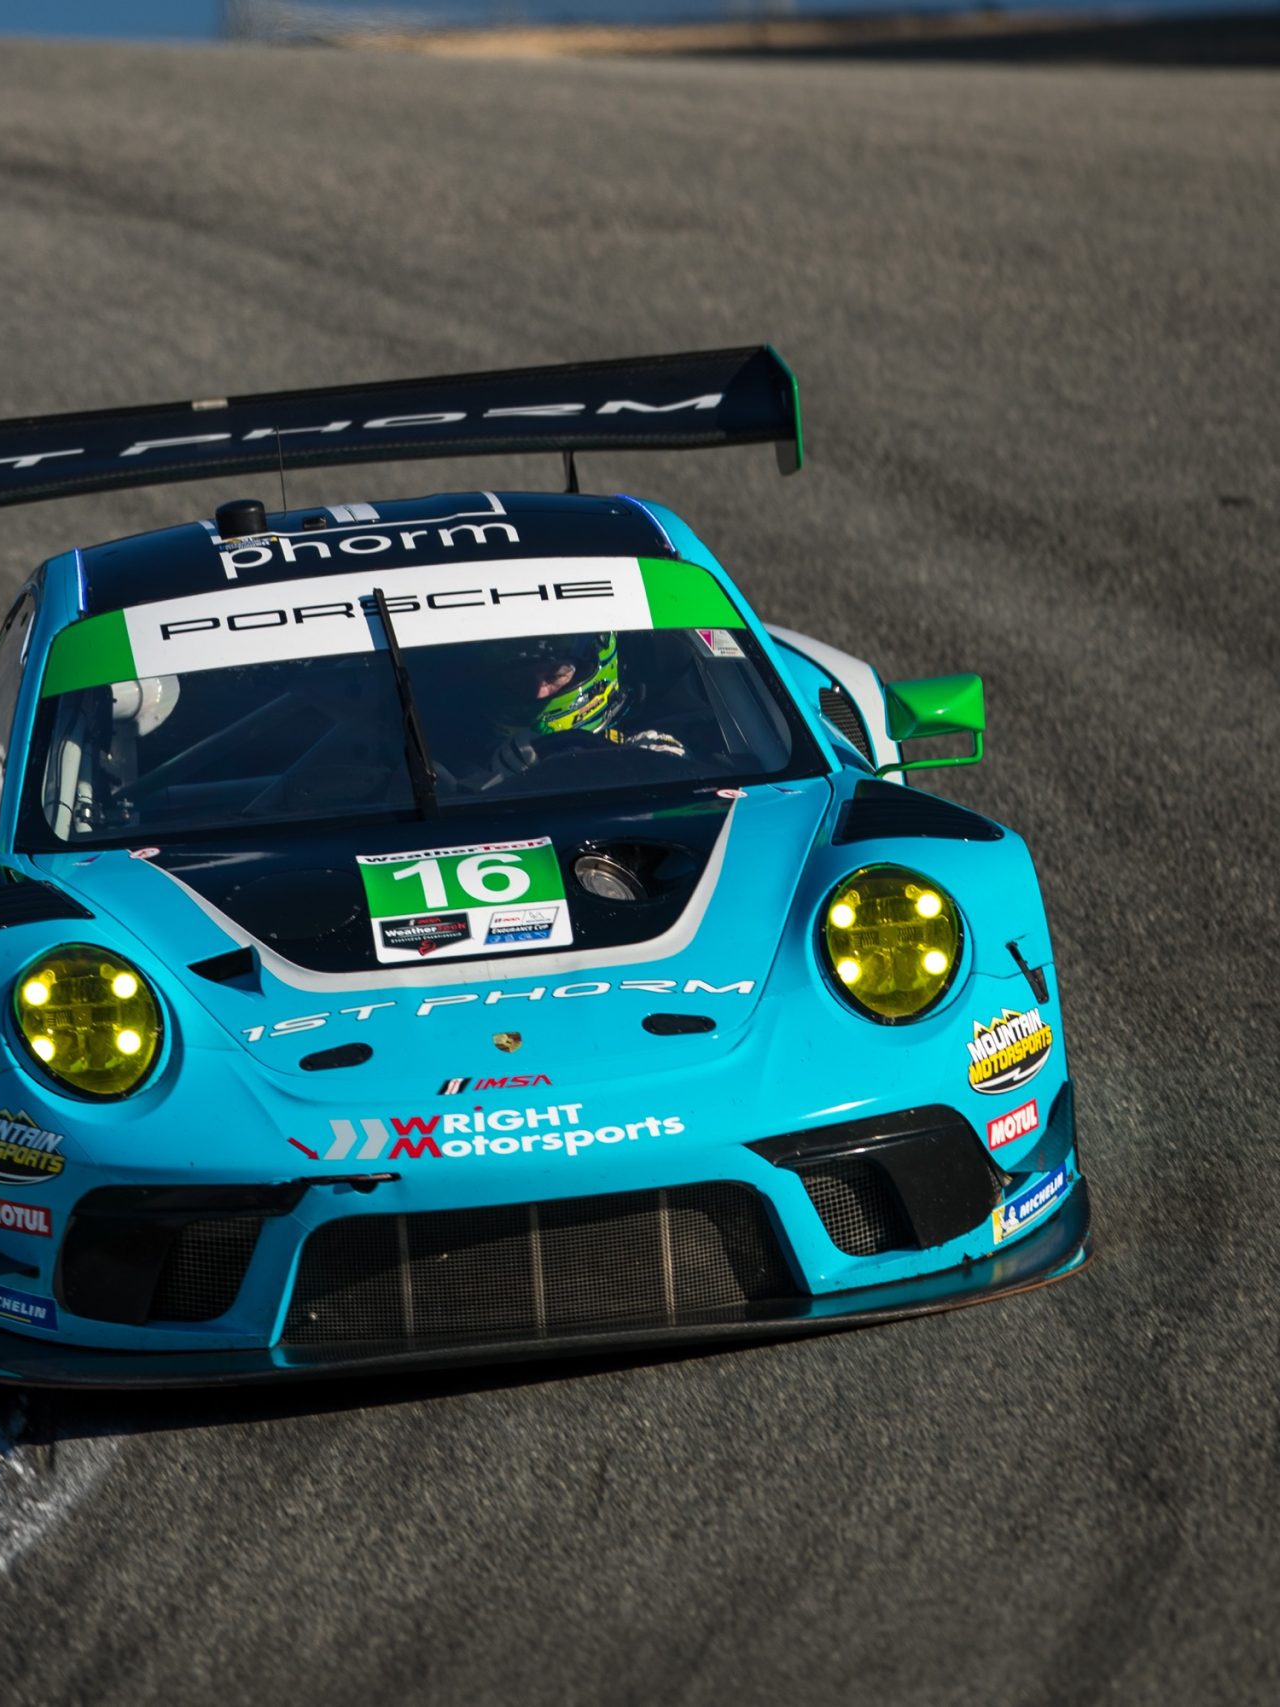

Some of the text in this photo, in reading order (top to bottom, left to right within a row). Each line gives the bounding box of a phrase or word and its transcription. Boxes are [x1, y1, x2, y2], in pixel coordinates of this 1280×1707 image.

[120, 393, 723, 456] PHORM
[219, 522, 521, 580] phorm
[160, 579, 613, 641] PORSCHE
[393, 853, 531, 909] 16
[241, 979, 757, 1042] 1ST PHORM
[967, 1008, 1042, 1063] MOUNTAIN
[473, 1074, 553, 1091] IMSA
[969, 1026, 1052, 1085] MOTORSPORTS
[388, 1114, 686, 1160] Motorsports
[991, 1103, 1038, 1147] MOTUL
[1020, 1171, 1064, 1219] MICHELIN
